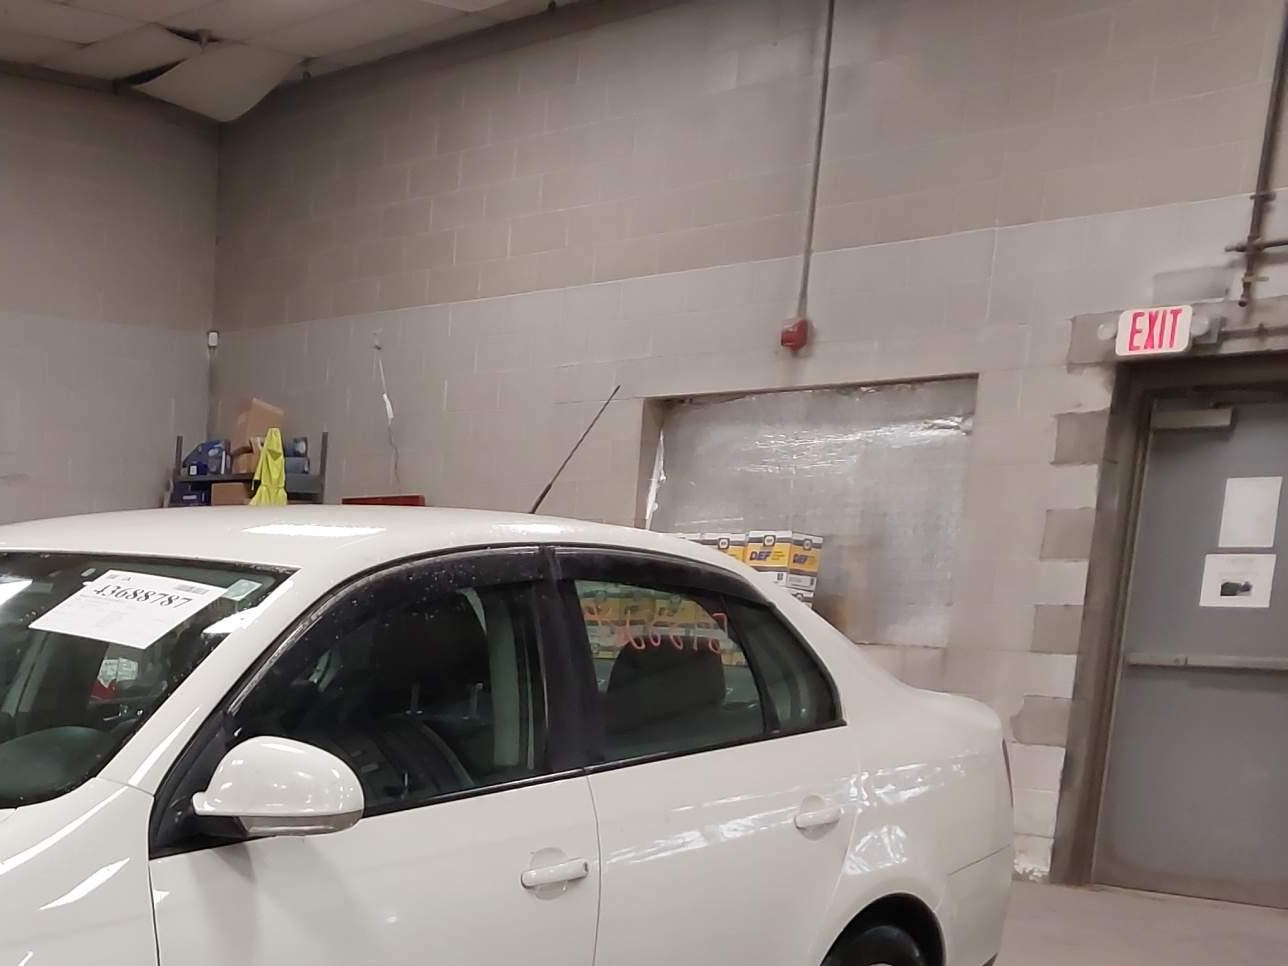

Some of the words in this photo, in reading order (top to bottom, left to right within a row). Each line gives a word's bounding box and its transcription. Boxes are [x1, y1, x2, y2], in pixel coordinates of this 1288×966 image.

[1128, 308, 1183, 352] EXIT
[749, 551, 772, 561] DEF
[93, 584, 193, 609] 43688787
